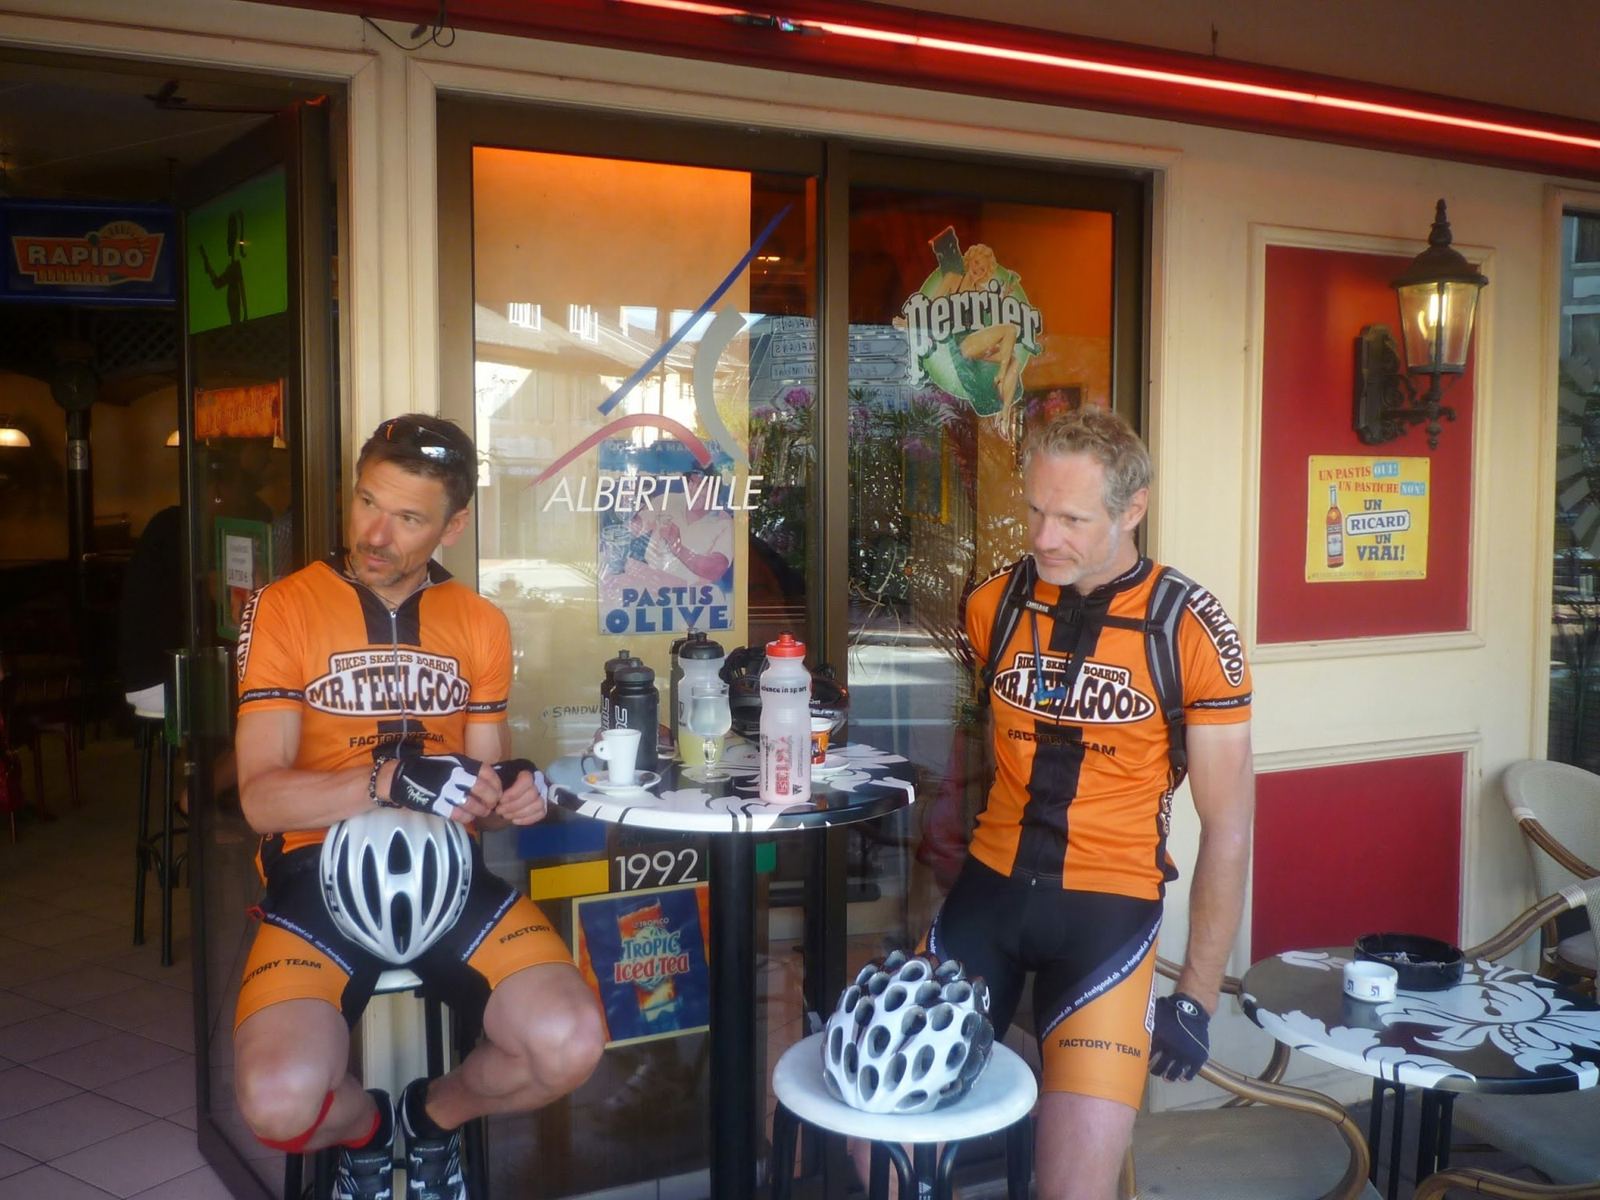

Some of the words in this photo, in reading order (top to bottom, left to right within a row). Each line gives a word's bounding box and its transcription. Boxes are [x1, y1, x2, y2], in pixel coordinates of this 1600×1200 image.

[28, 244, 145, 268] RAPIDO
[1318, 470, 1333, 481] UN
[1335, 466, 1371, 479] PASTIS
[543, 476, 764, 512] ALBERTVILLE
[1339, 481, 1352, 492] UN
[1354, 482, 1399, 494] PASTICHE
[1363, 499, 1382, 511] UN
[1350, 515, 1406, 531] RICARD
[1375, 533, 1392, 545] UN
[1356, 544, 1405, 561] VRAI!
[622, 586, 713, 607] PASTIS
[605, 605, 728, 633] OLIVE
[334, 656, 368, 673] BIKES
[369, 654, 414, 665] SKATES
[416, 655, 455, 676] BOARDS
[1083, 665, 1127, 686] BOARDS
[552, 704, 600, 718] SANDW
[615, 848, 699, 891] 1992
[499, 924, 551, 944] FACTORY
[623, 930, 681, 959] TROPIC
[242, 959, 281, 989] ACTORY
[285, 958, 322, 969] TEAM
[1058, 1038, 1112, 1050] FACTORY
[1115, 1043, 1141, 1057] TEAM
